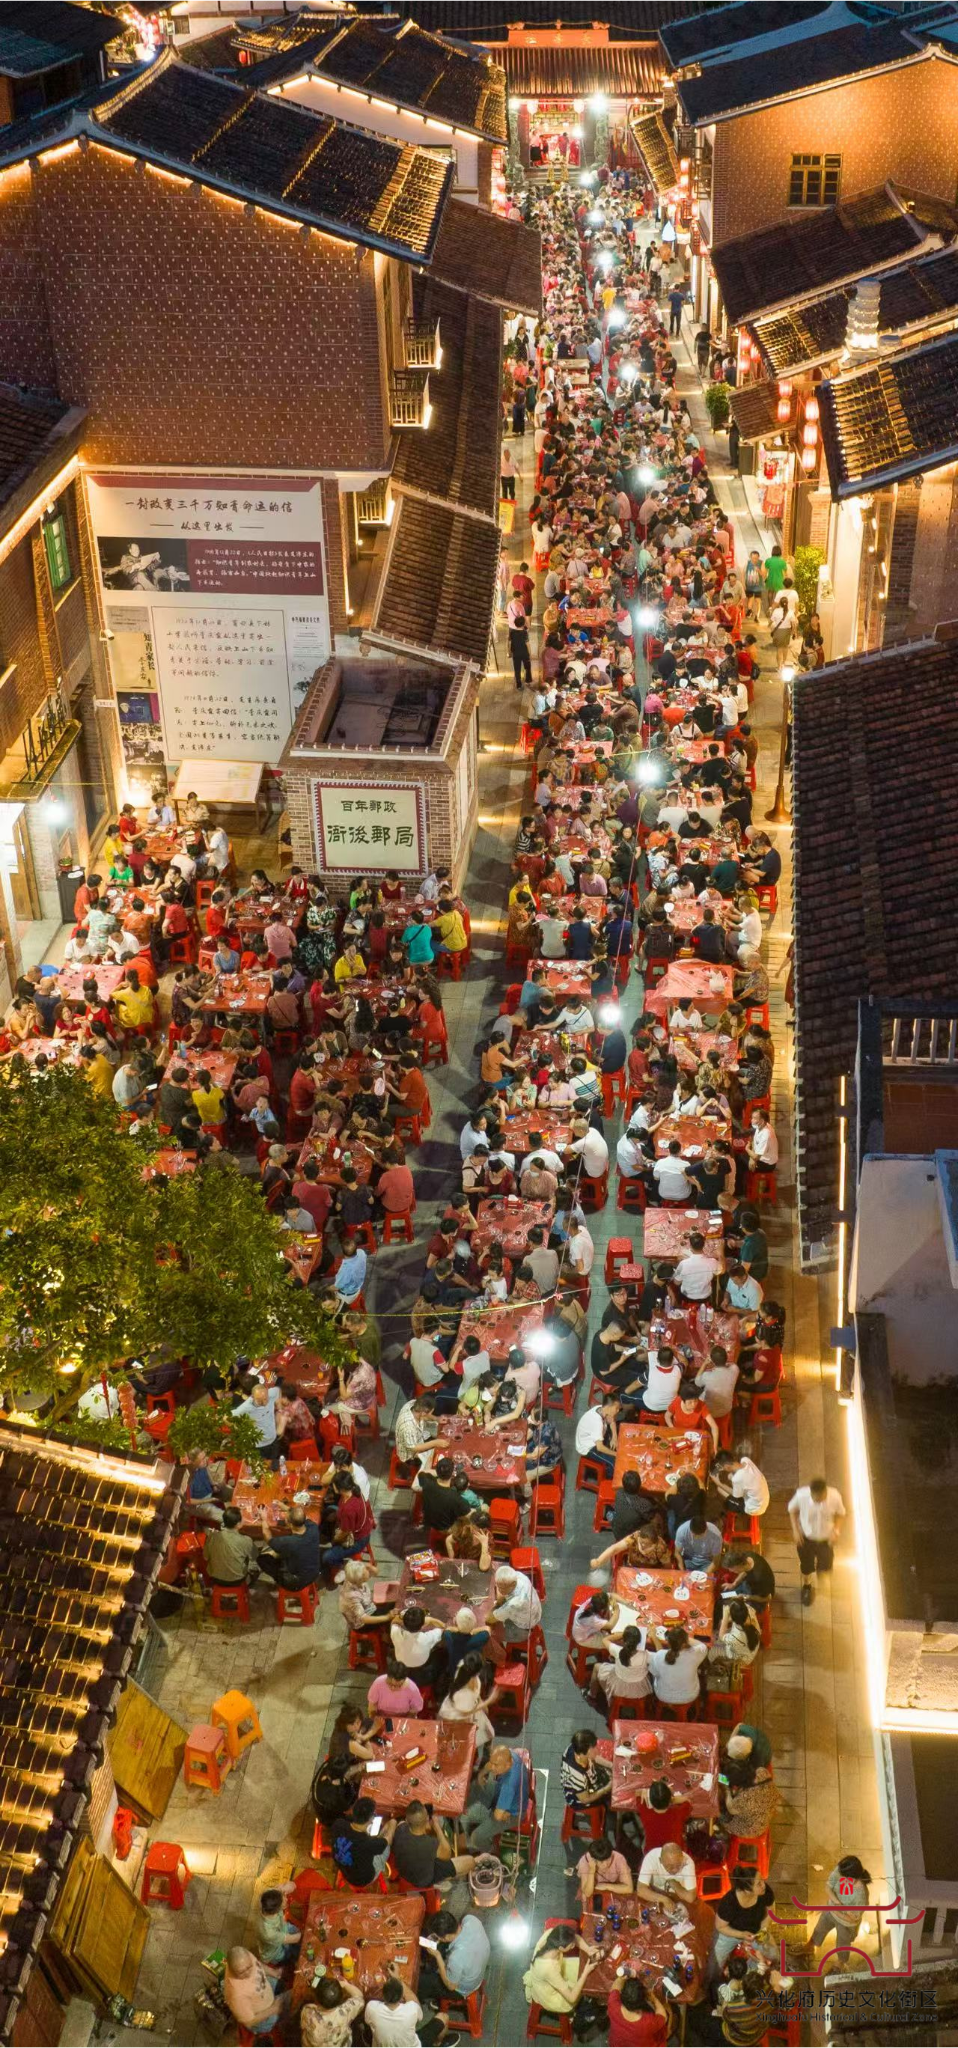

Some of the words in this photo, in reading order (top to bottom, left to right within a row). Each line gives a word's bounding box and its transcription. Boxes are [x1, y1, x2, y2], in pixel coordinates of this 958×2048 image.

[125, 497, 293, 513] 一封改变三千万知青命运的信
[341, 800, 397, 813] 百年郵政
[327, 825, 414, 847] 衙後郵局
